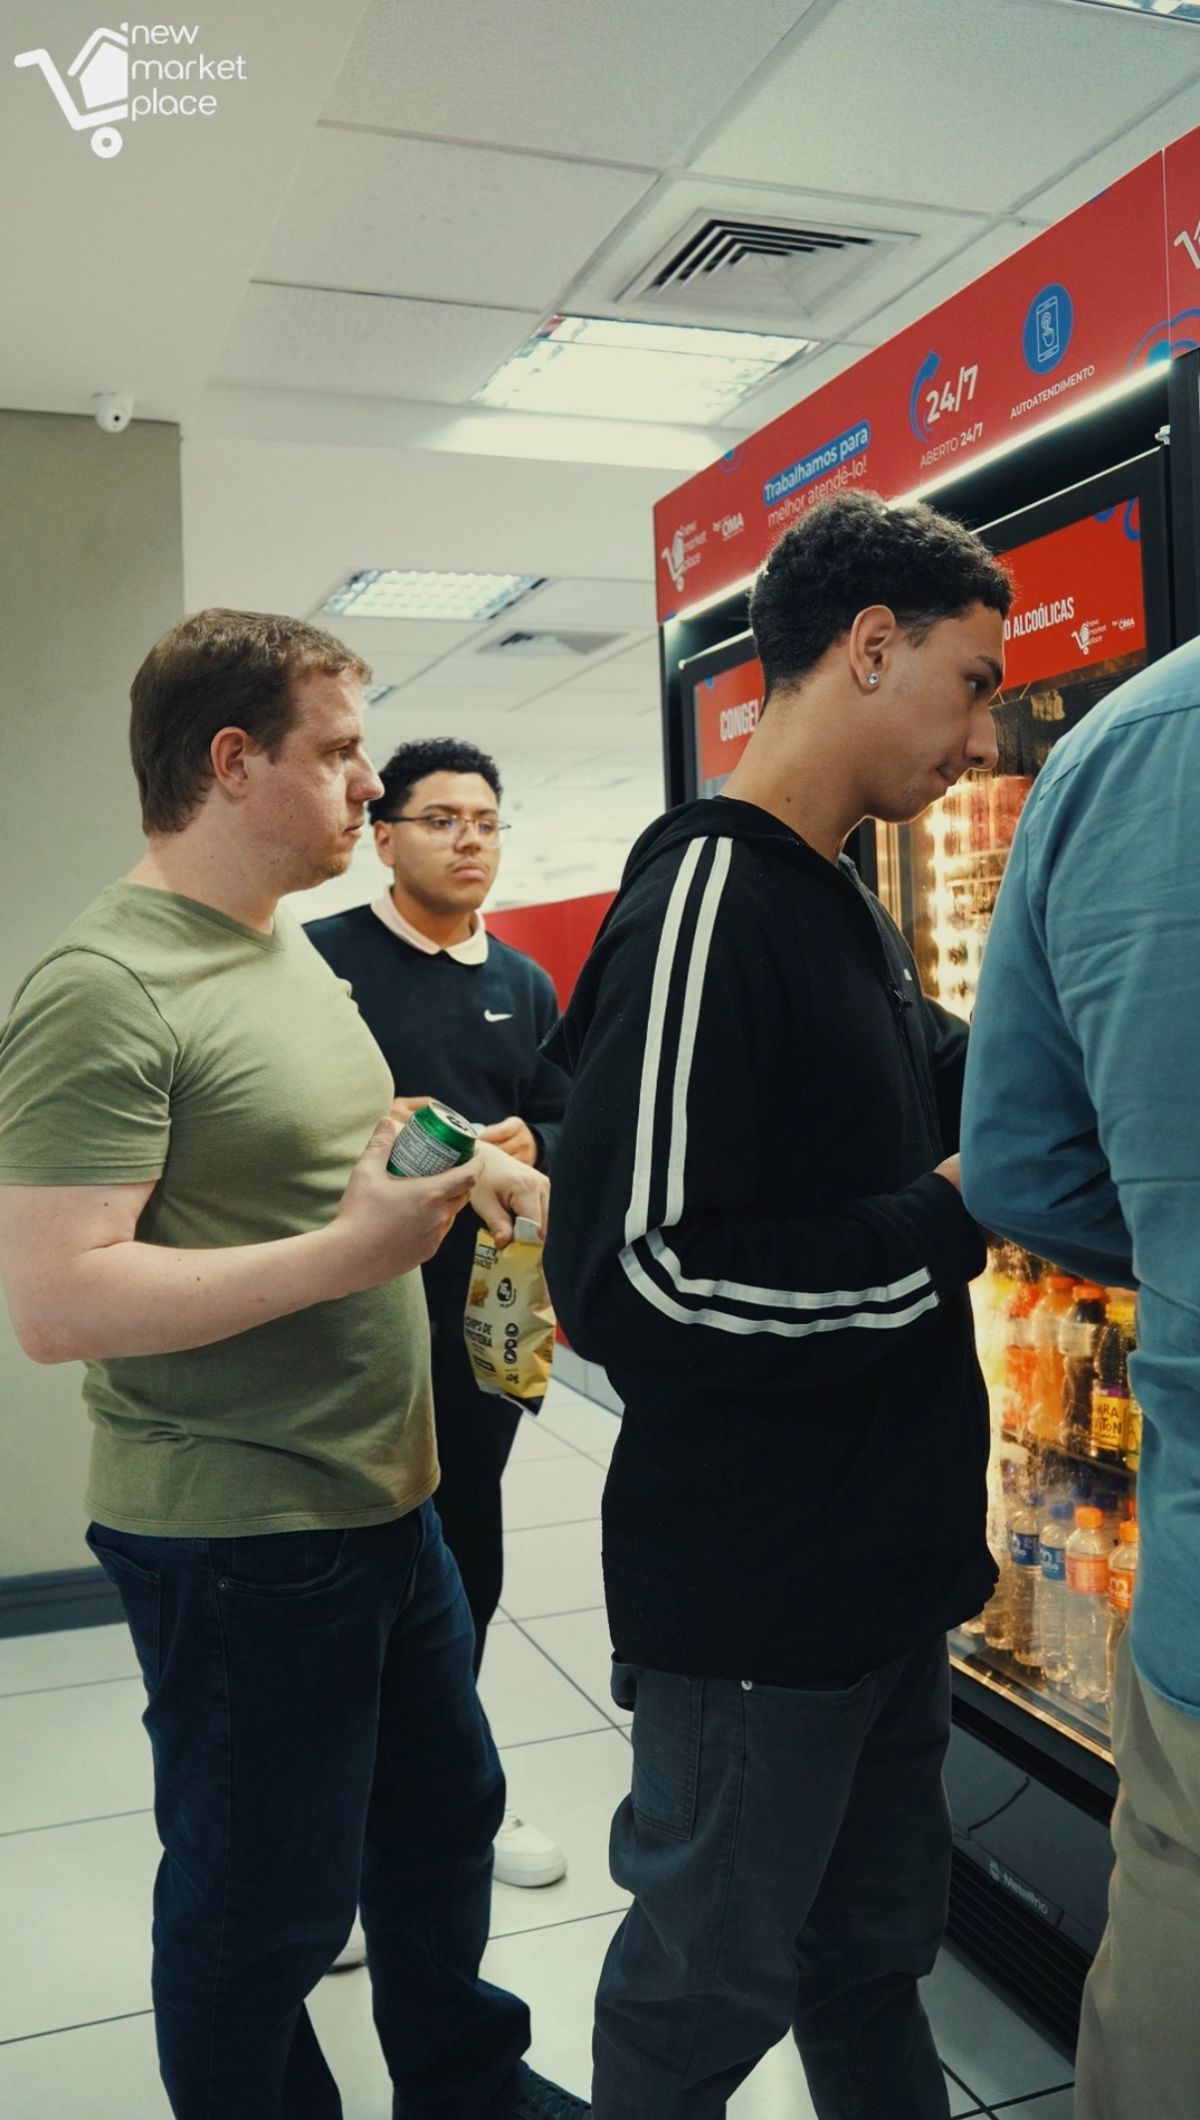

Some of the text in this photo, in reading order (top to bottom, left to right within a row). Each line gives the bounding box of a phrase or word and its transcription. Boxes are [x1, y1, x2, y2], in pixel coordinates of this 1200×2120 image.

[926, 364, 978, 424] 24/7
[1010, 365, 1095, 419] AUTOATENDIMENTO
[764, 427, 868, 501] Trabalhamos para
[920, 422, 983, 469] ABERTO 24/7
[768, 455, 867, 527] melhor atendê-lo!
[1013, 596, 1074, 638] ALCOÓLICAS
[720, 698, 760, 741] CONGEL
